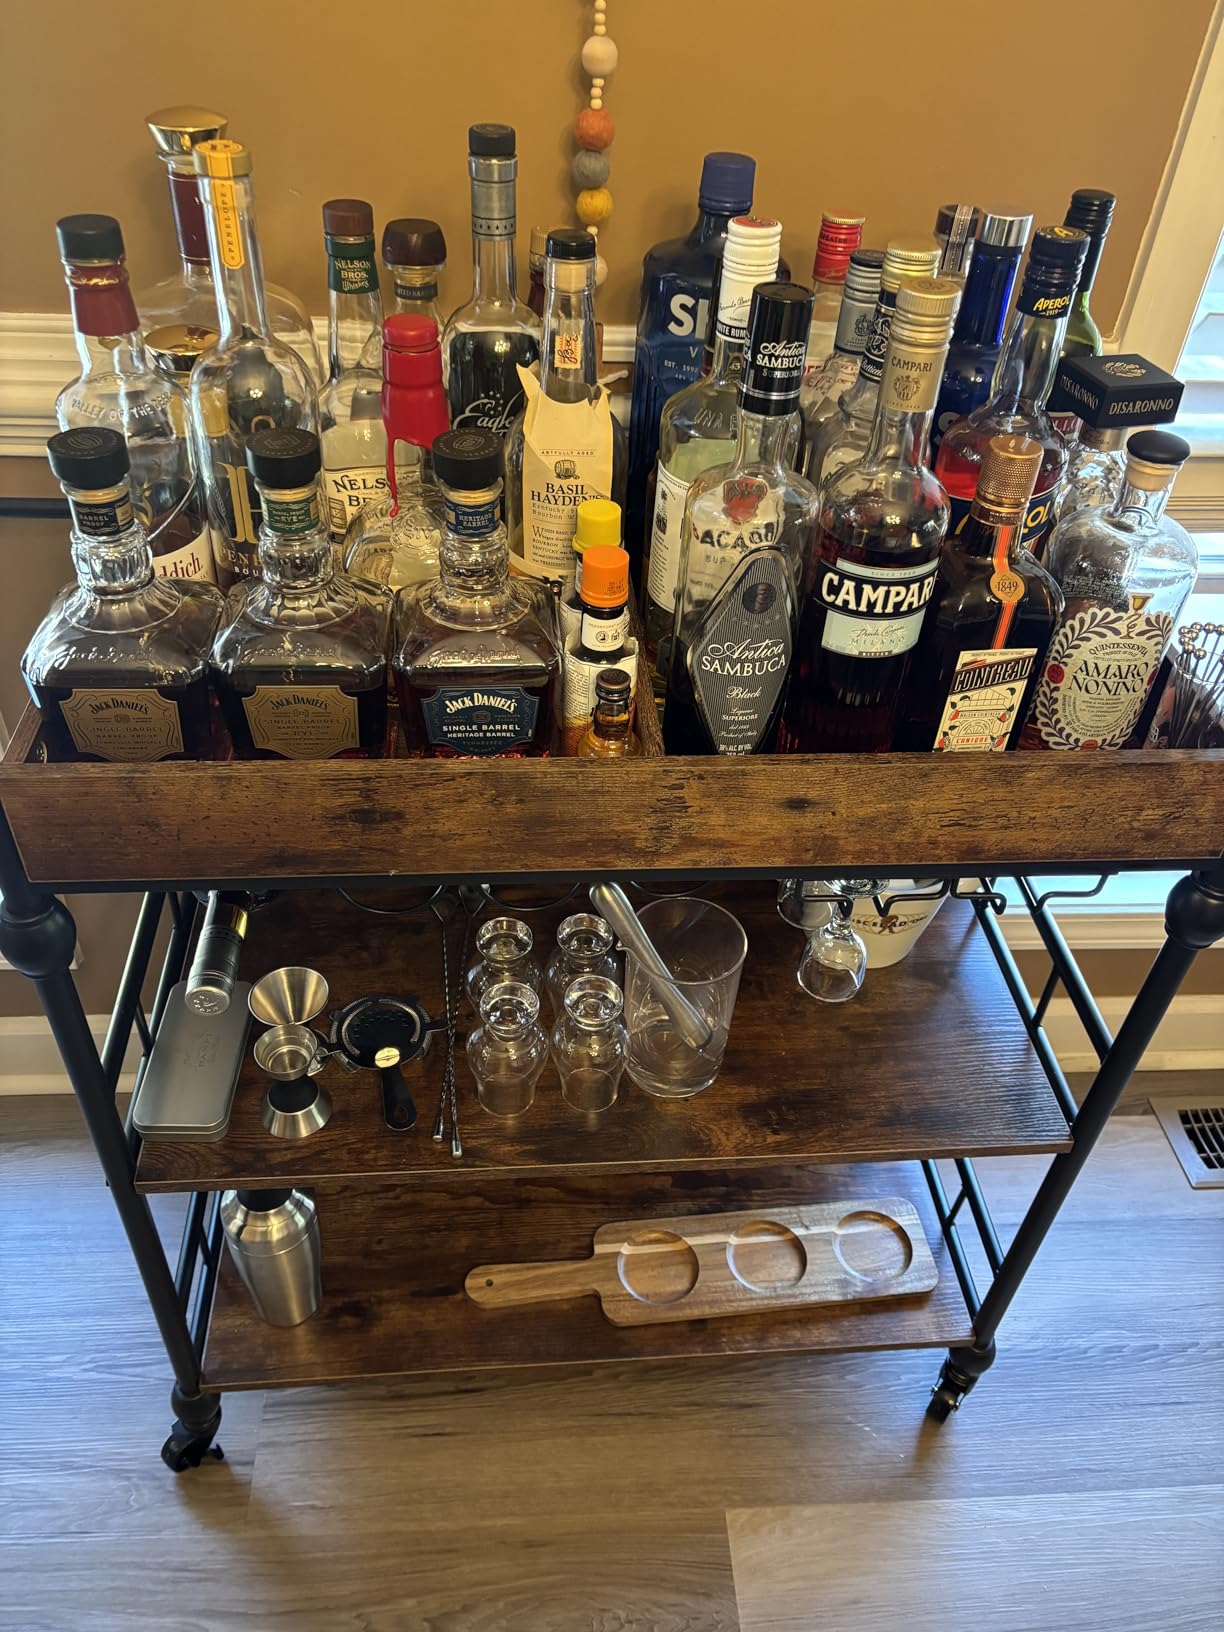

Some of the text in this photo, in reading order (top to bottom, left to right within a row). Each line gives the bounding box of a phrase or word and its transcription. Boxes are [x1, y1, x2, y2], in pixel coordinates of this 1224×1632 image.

[334, 258, 371, 270] NELSON
[1033, 295, 1071, 312] APEROL
[891, 356, 933, 373] CAMPARI
[129, 402, 154, 419] THE
[1108, 398, 1175, 416] DISARONNO
[332, 474, 387, 493] NELS
[546, 482, 589, 496] BASIL
[532, 502, 565, 514] Kentucky
[532, 510, 563, 520] Bourbon
[997, 580, 1018, 592] 1849
[708, 639, 785, 659] Antica
[851, 637, 905, 646] MILANO
[701, 654, 786, 676] SAMBUCA
[1074, 660, 1149, 680] AMARO
[952, 657, 1033, 693] COINTREAU
[726, 686, 762, 699] Black
[1067, 674, 1144, 696] NONINO
[89, 701, 112, 714] JACK
[270, 698, 291, 710] JACK
[445, 692, 518, 713] JACK DANIEL'S
